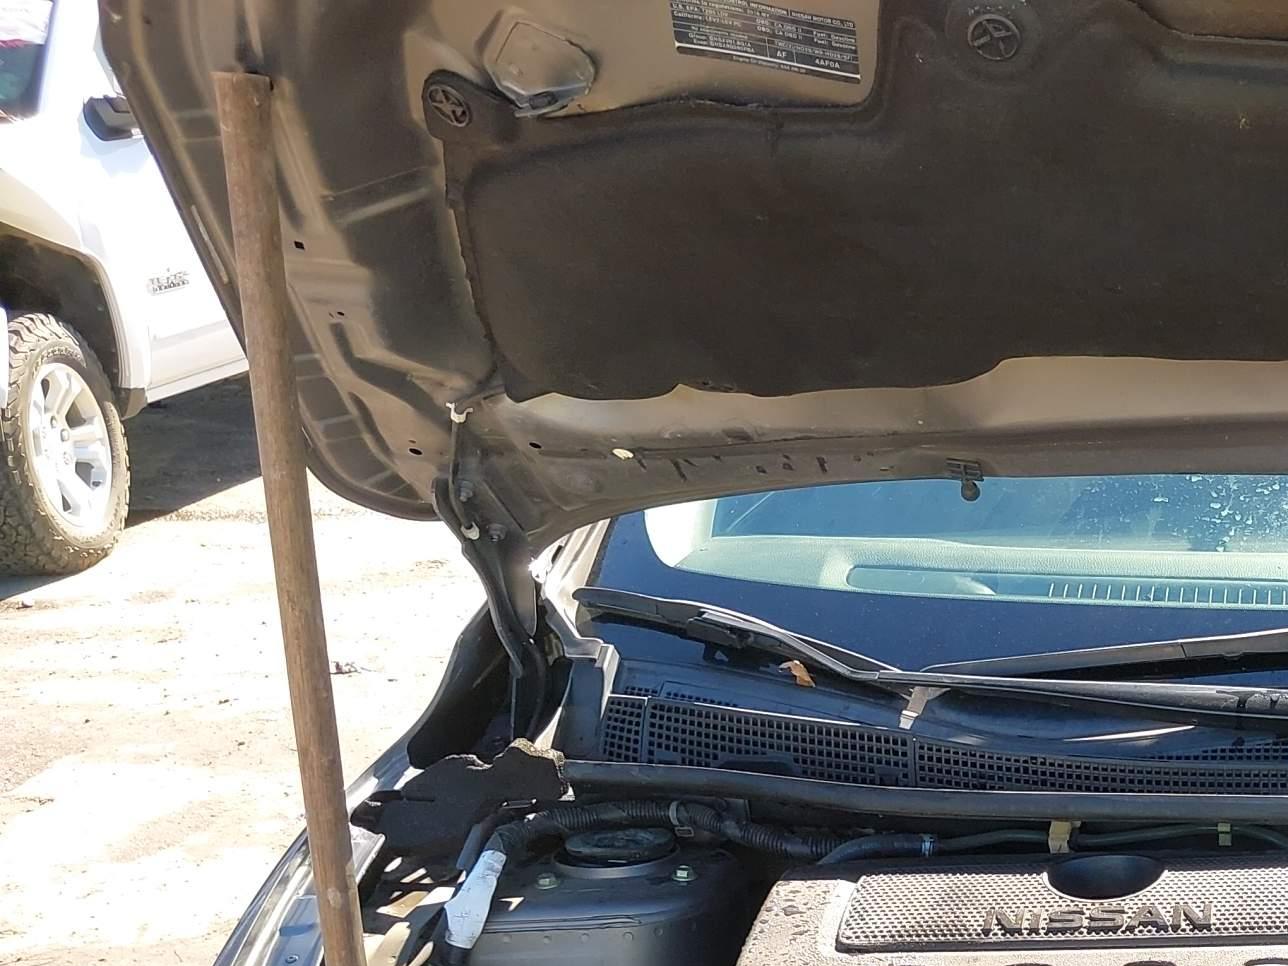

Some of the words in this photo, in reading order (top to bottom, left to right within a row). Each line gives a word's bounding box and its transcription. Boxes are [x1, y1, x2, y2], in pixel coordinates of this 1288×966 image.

[791, 11, 812, 20] NISSAN
[812, 15, 832, 24] MOTOR
[776, 50, 788, 59] AF
[982, 903, 1213, 935] NISSAN
